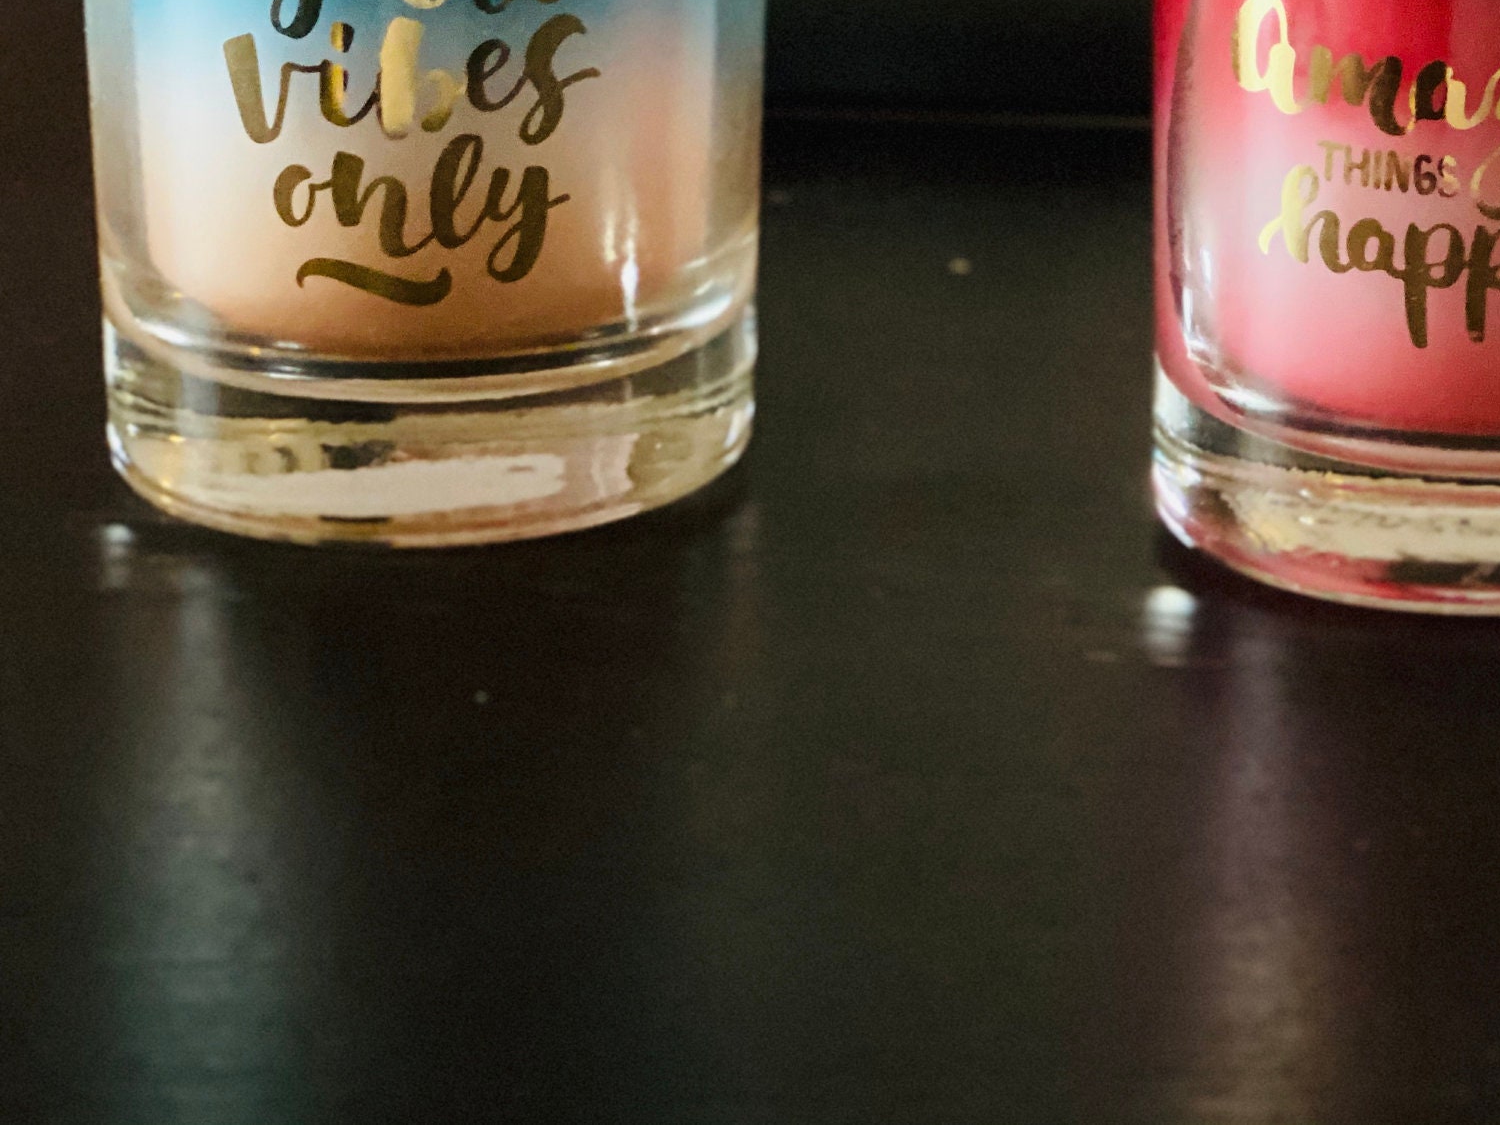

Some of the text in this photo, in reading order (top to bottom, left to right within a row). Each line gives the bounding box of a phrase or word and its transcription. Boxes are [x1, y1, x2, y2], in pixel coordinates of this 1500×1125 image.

[223, 13, 601, 145] vibes
[273, 133, 570, 282] only
[1317, 139, 1458, 198] THINGS
